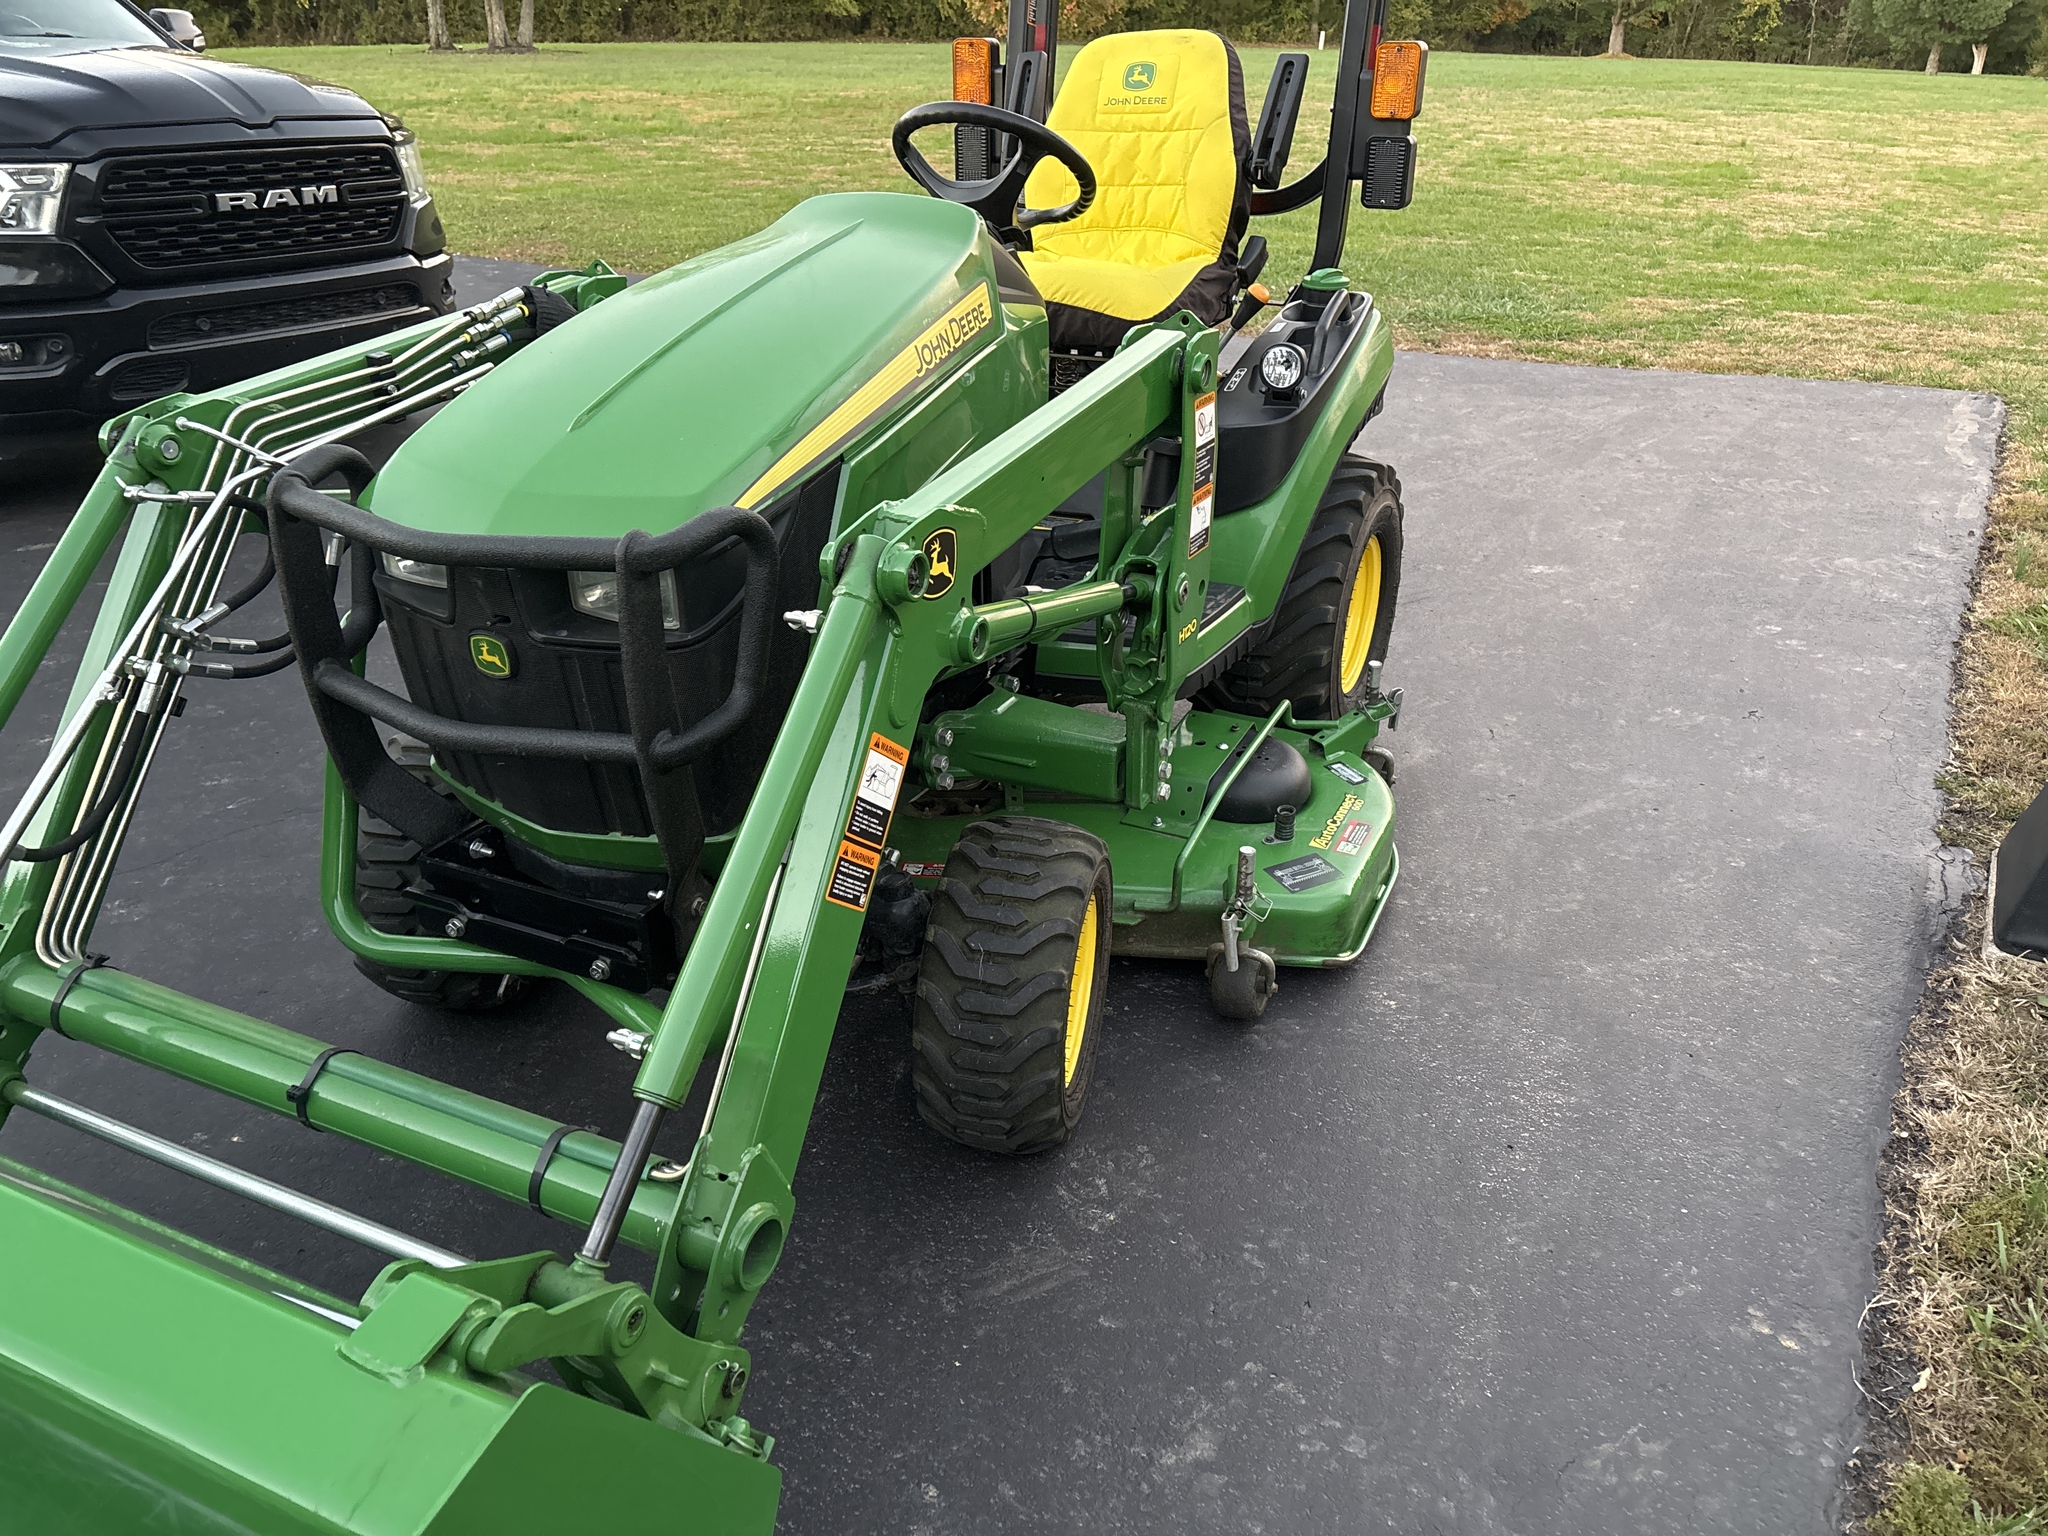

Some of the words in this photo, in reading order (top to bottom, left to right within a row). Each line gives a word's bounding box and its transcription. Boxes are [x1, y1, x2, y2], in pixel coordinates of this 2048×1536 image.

[1103, 96, 1132, 107] JOHN
[1133, 95, 1168, 105] DEERE
[214, 184, 339, 212] RAM
[913, 328, 952, 375] JOHN
[947, 302, 987, 345] DEERE
[880, 741, 904, 761] WARNING
[1313, 793, 1358, 849] AutoConnect
[850, 849, 875, 866] WARNING
